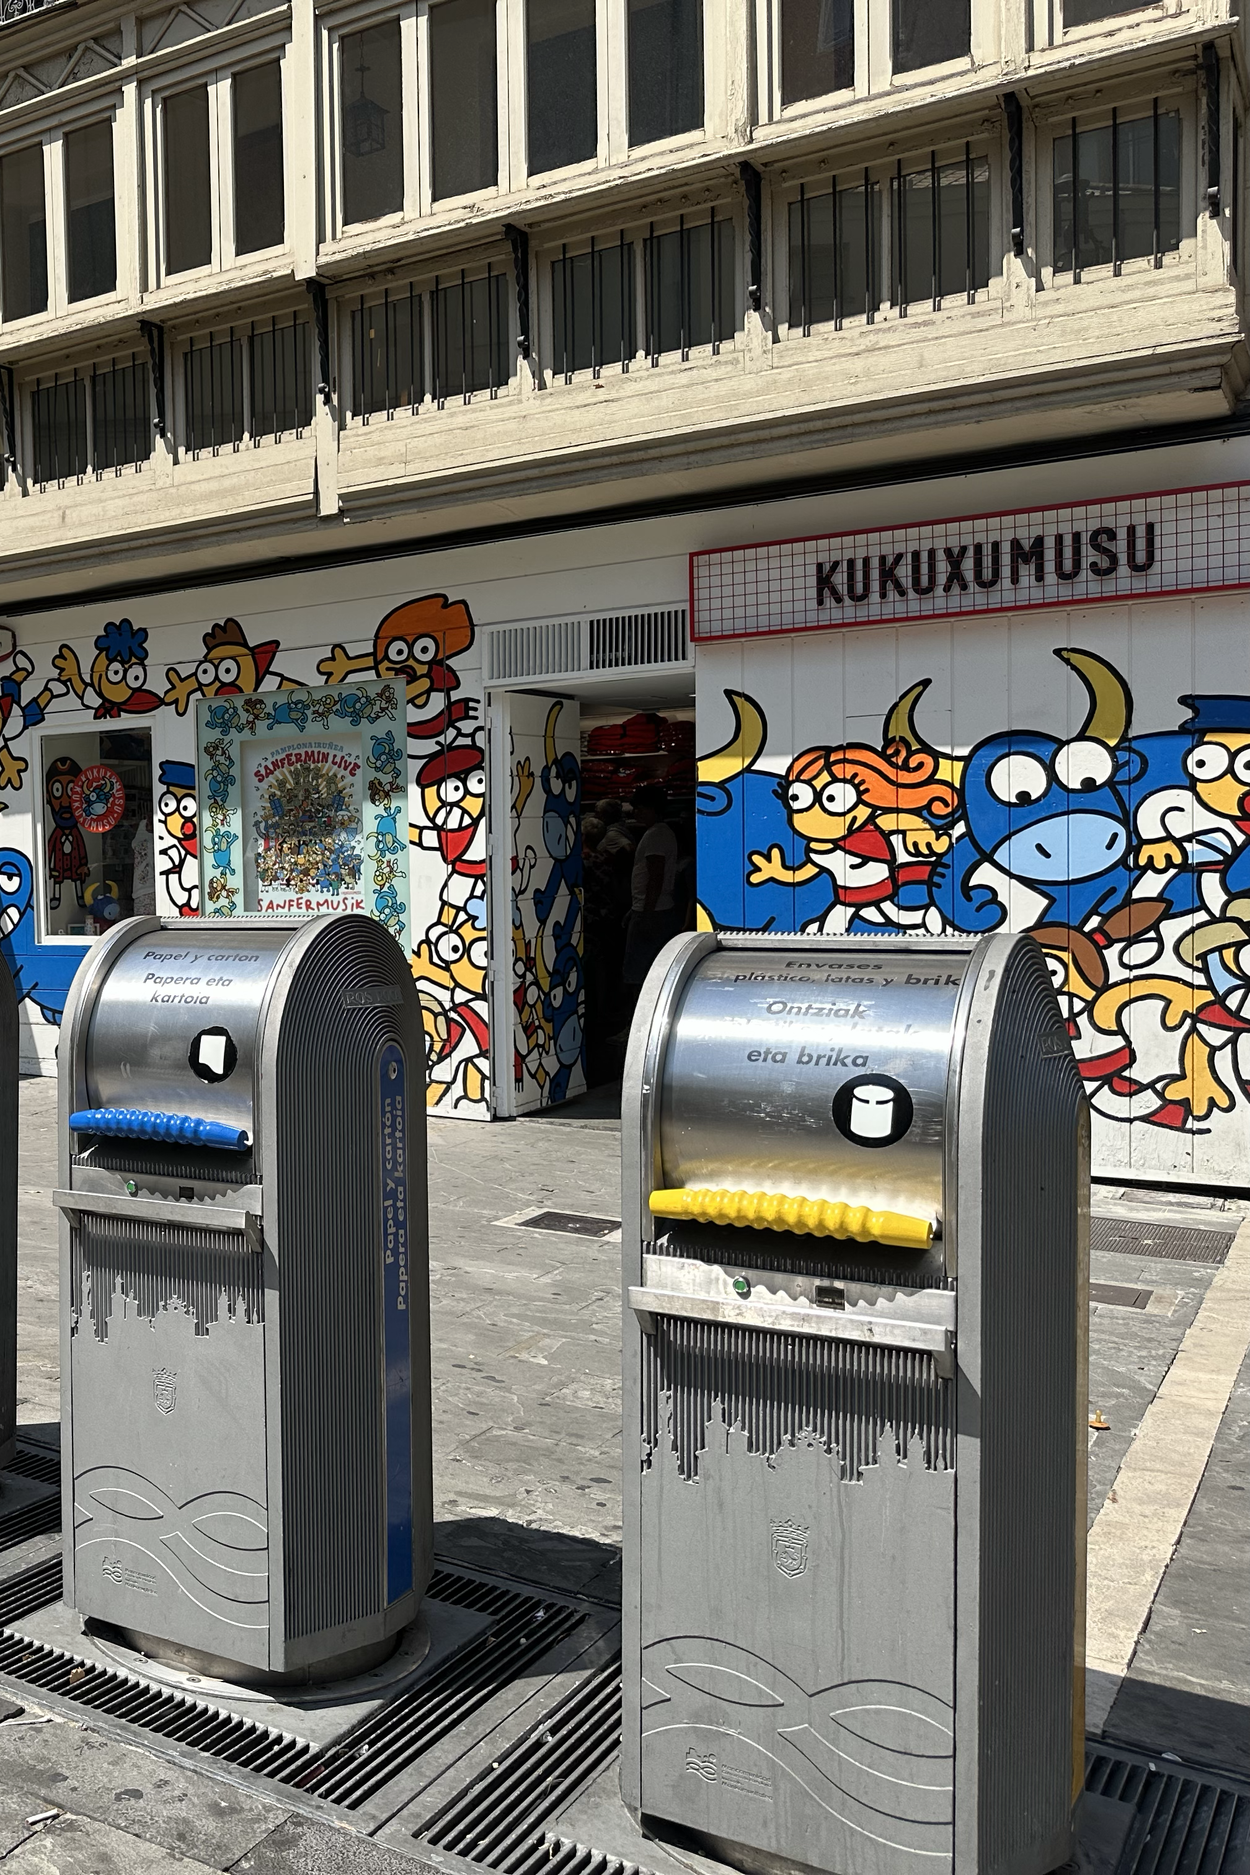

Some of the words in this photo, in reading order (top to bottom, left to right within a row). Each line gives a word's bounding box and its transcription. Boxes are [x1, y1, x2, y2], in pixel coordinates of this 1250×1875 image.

[816, 522, 1155, 607] KUKUXUMUSU
[270, 742, 314, 758] PAMPLONA
[313, 742, 344, 752] IRUÑEA
[254, 750, 330, 783] SANFERMIN
[331, 753, 361, 777] LIVE
[143, 950, 190, 964] Papel
[190, 953, 203, 965] y
[784, 960, 883, 971] Envases
[143, 972, 202, 987] Papera
[206, 975, 233, 988] eta
[733, 972, 816, 984] plástico,
[824, 973, 875, 985] latas
[880, 977, 896, 988] y
[904, 973, 962, 987] brik
[150, 990, 211, 1006] kartoia
[765, 1000, 867, 1020] Ontziak
[746, 1048, 788, 1064] eta
[796, 1046, 870, 1068] brika
[381, 1097, 392, 1170] cartón
[393, 1096, 404, 1178] kartoia
[385, 1177, 395, 1190] y
[397, 1186, 405, 1220] eta
[384, 1204, 395, 1265] Papel
[396, 1230, 407, 1311] Papera
